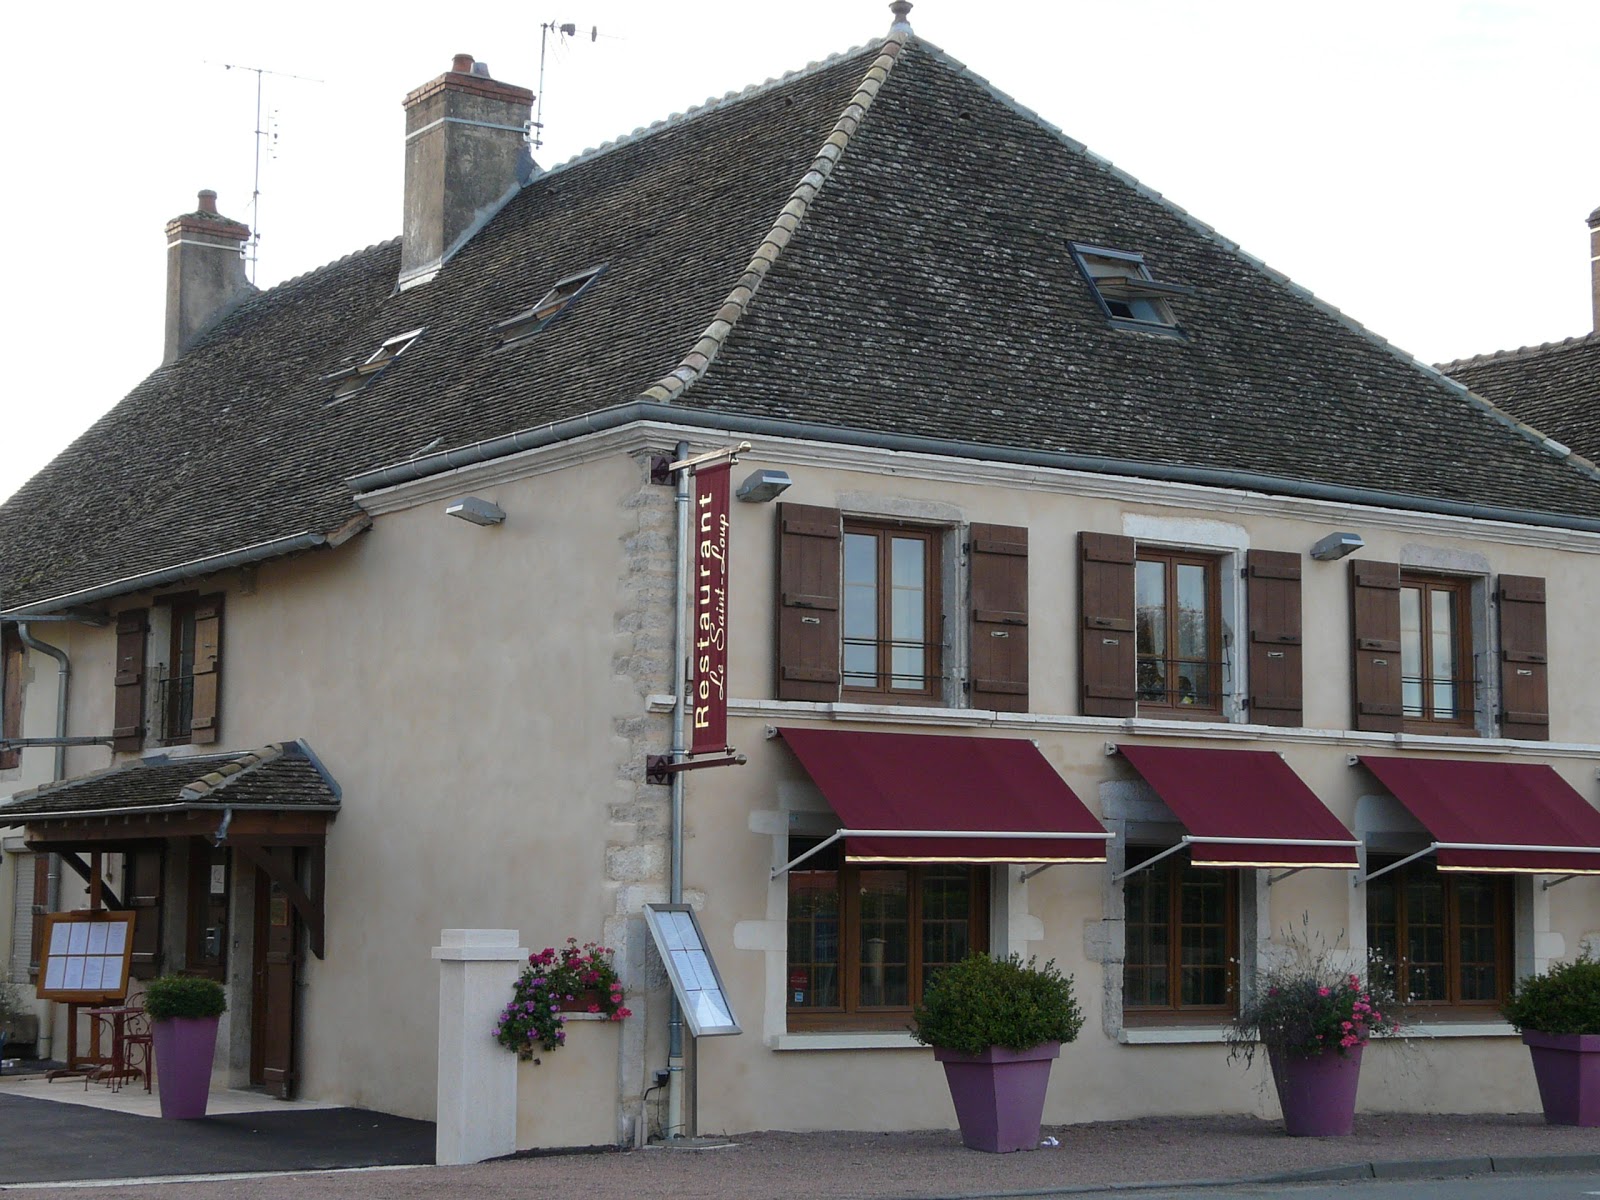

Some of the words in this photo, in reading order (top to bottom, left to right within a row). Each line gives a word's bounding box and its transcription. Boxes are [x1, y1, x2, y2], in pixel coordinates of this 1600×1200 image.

[695, 492, 712, 728] Restaurant
[709, 513, 730, 651] Saint-Loup
[710, 663, 724, 700] Le
